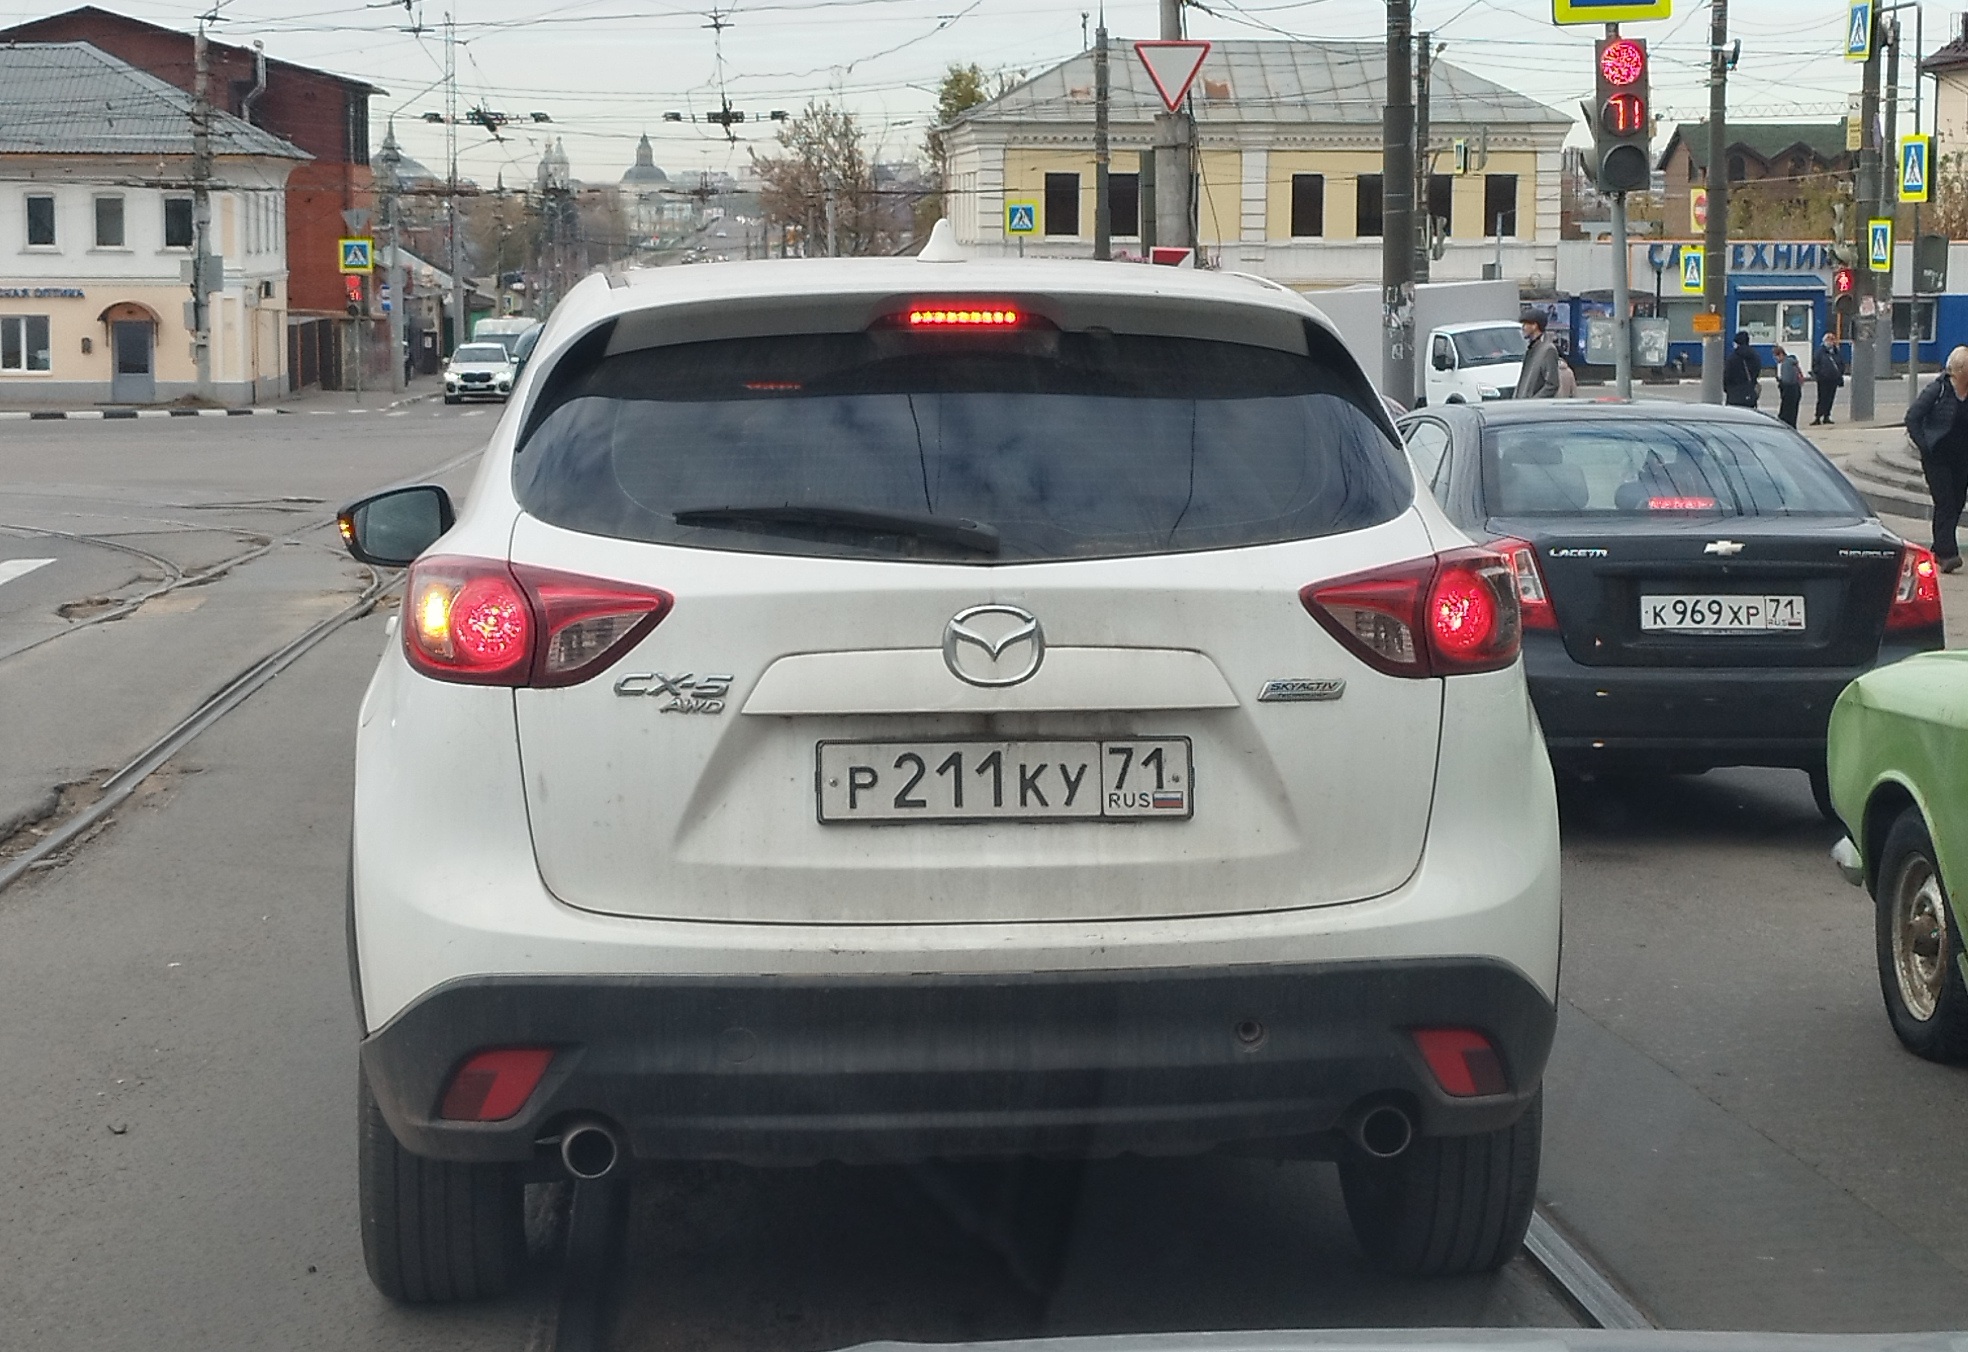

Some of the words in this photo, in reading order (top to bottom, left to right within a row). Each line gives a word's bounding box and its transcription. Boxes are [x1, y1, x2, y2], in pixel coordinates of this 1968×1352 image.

[1608, 99, 1639, 130] 71
[1768, 599, 1795, 619] 71
[613, 672, 734, 699] CX-5
[1269, 682, 1339, 691] SKYACTIV
[659, 697, 725, 714] AWD
[1108, 747, 1164, 790] 71
[1108, 792, 1151, 808] RUS
